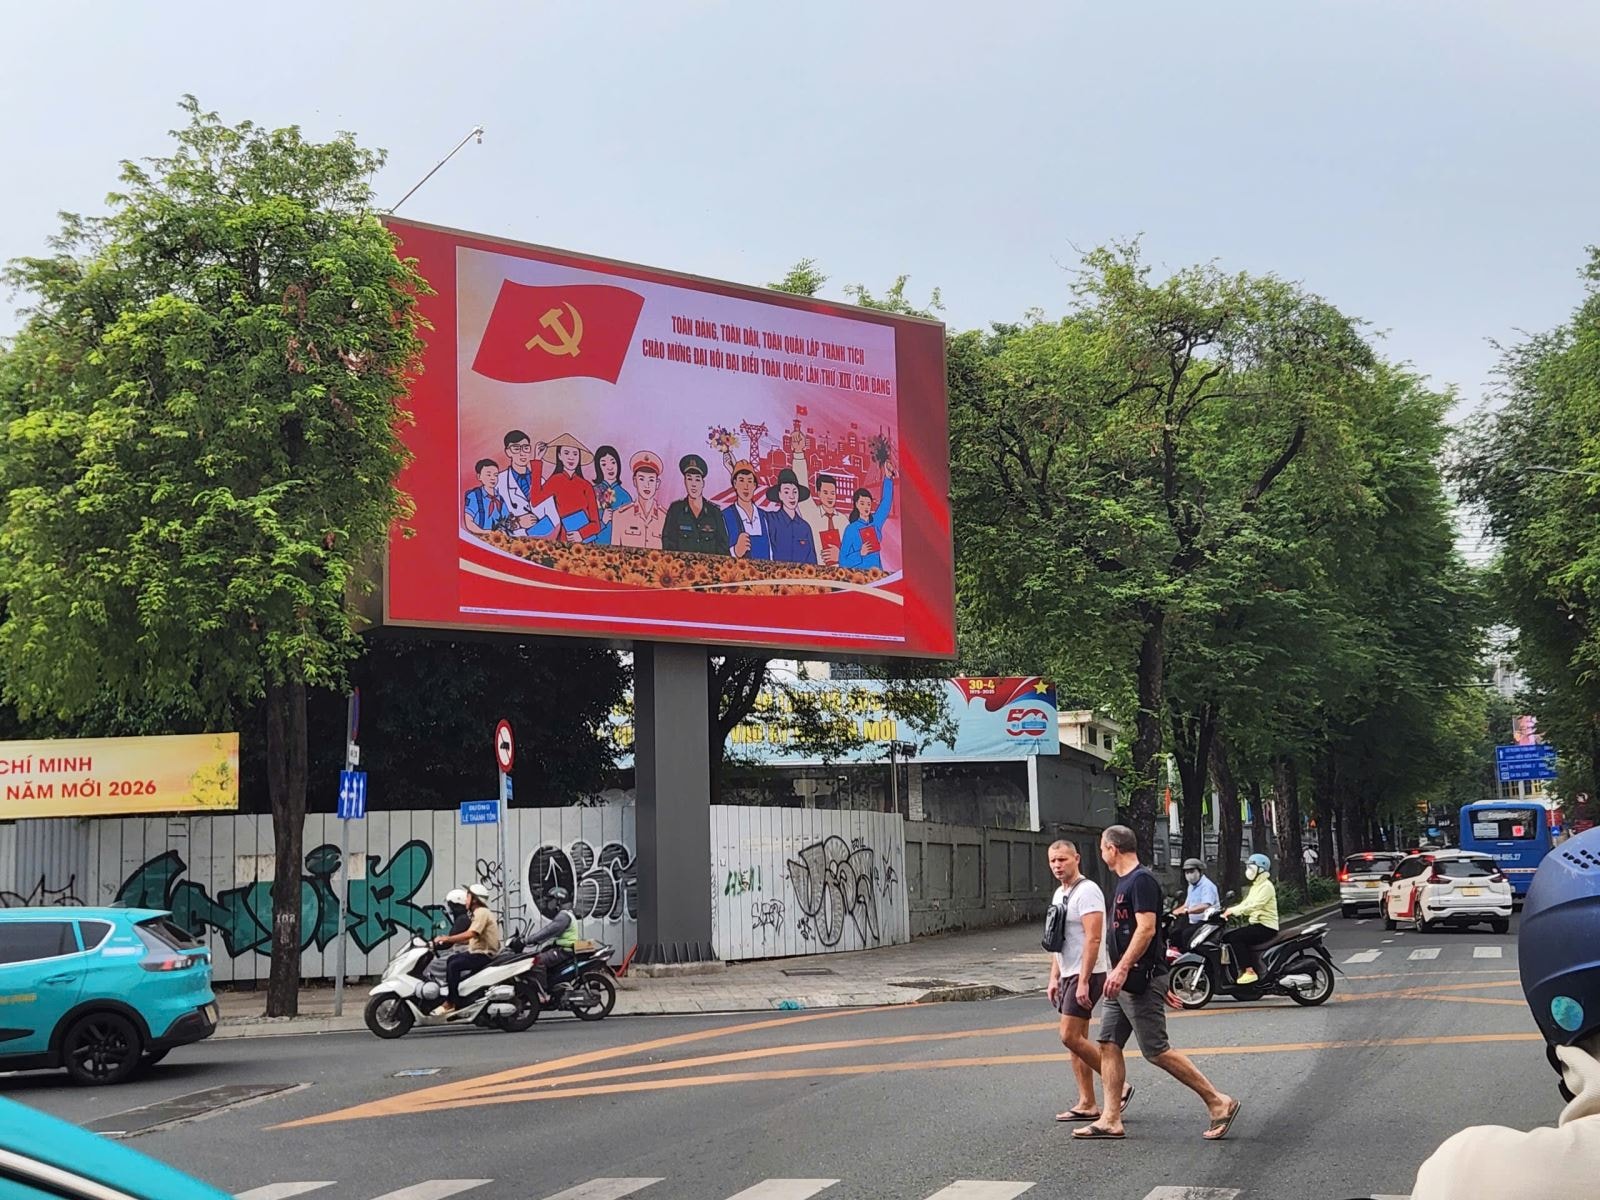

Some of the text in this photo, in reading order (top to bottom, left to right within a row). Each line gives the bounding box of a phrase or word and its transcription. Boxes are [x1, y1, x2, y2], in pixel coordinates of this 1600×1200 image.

[671, 315, 865, 365] TOÀN ĐẢNG, TOÀN DÂN, TOÀN QUÂN LẬP THÀNH TÍCH
[642, 338, 892, 396] CHÀO MỪNG ĐẠI HỘI ĐẠI BIỂU TOÀN QUỐC LẦN THỨ XIV CỦA ĐẢNG
[968, 680, 995, 690] 30-4
[863, 716, 897, 742] MỚI
[39, 757, 92, 773] MINH
[7, 778, 157, 801] NĂM MỚI 2026
